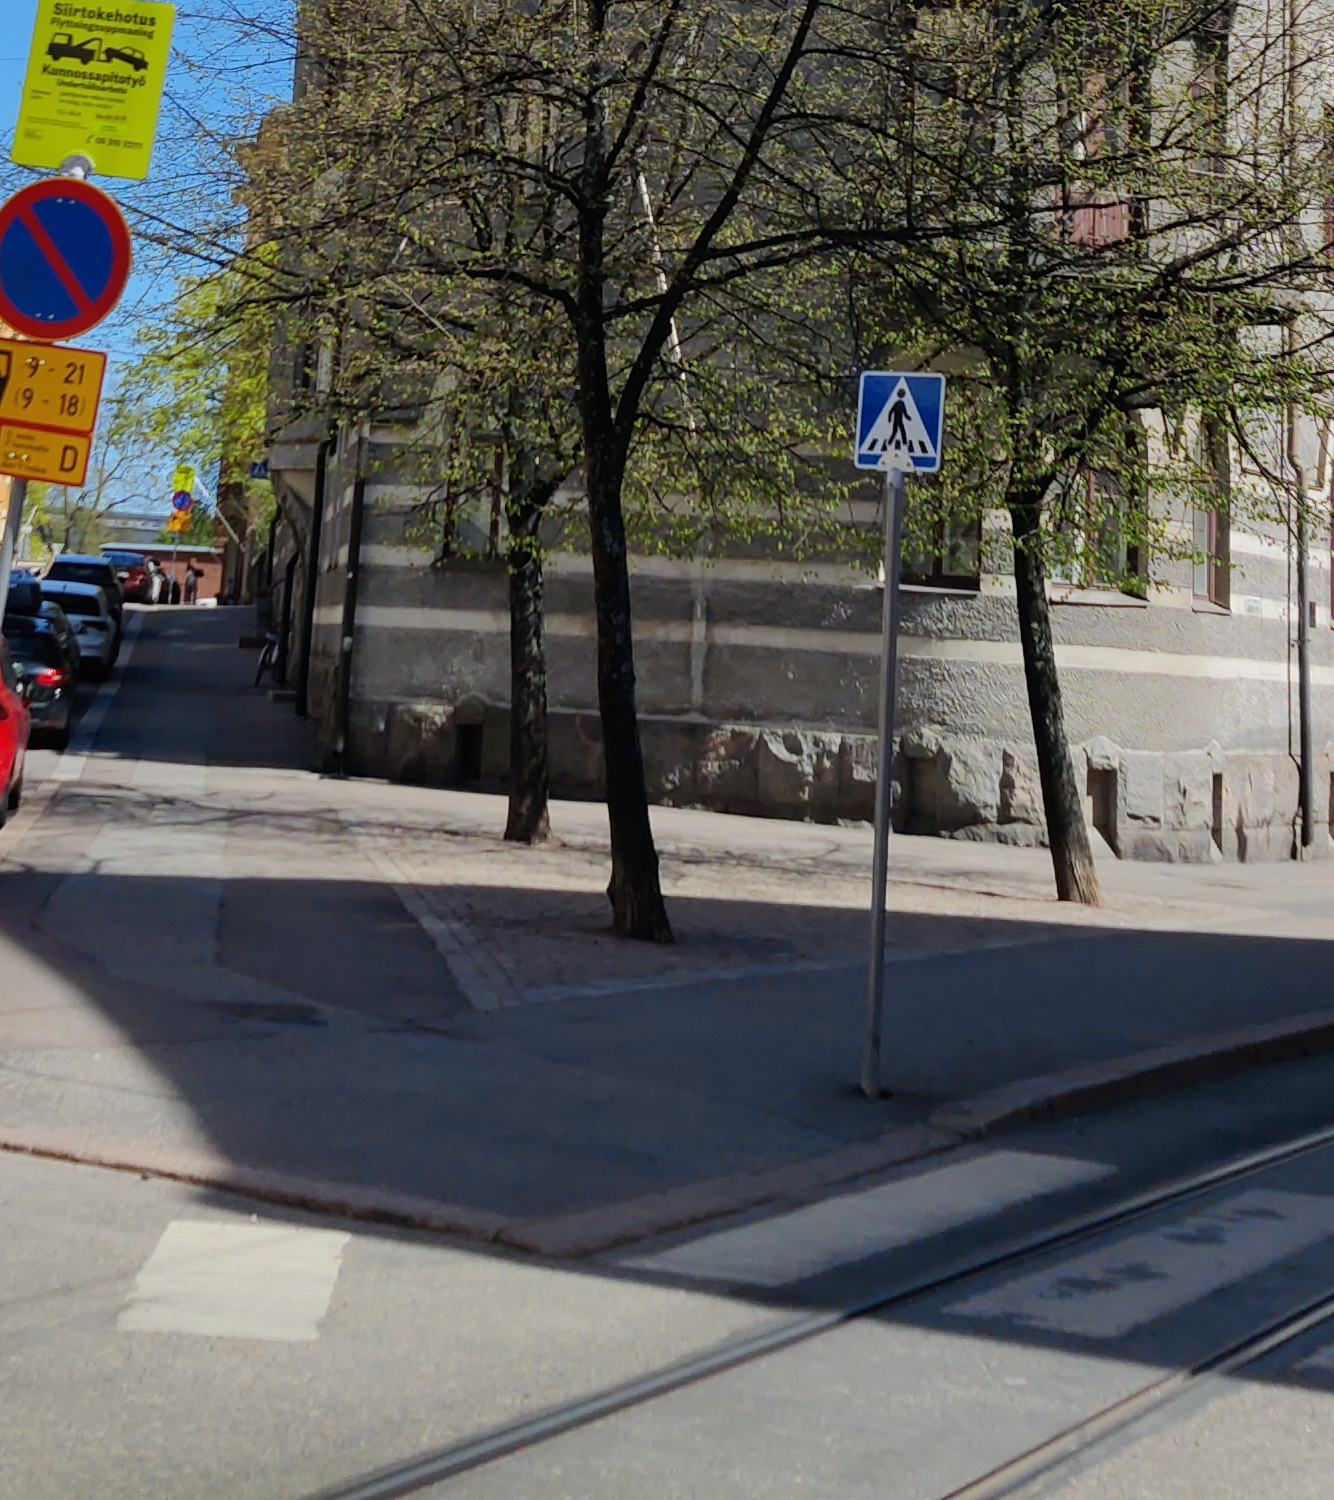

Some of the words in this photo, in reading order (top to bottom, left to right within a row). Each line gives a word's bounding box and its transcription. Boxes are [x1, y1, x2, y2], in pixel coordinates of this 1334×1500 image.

[54, 3, 156, 26] Siirtokehotus
[62, 361, 86, 385] 21
[59, 444, 78, 472] D
